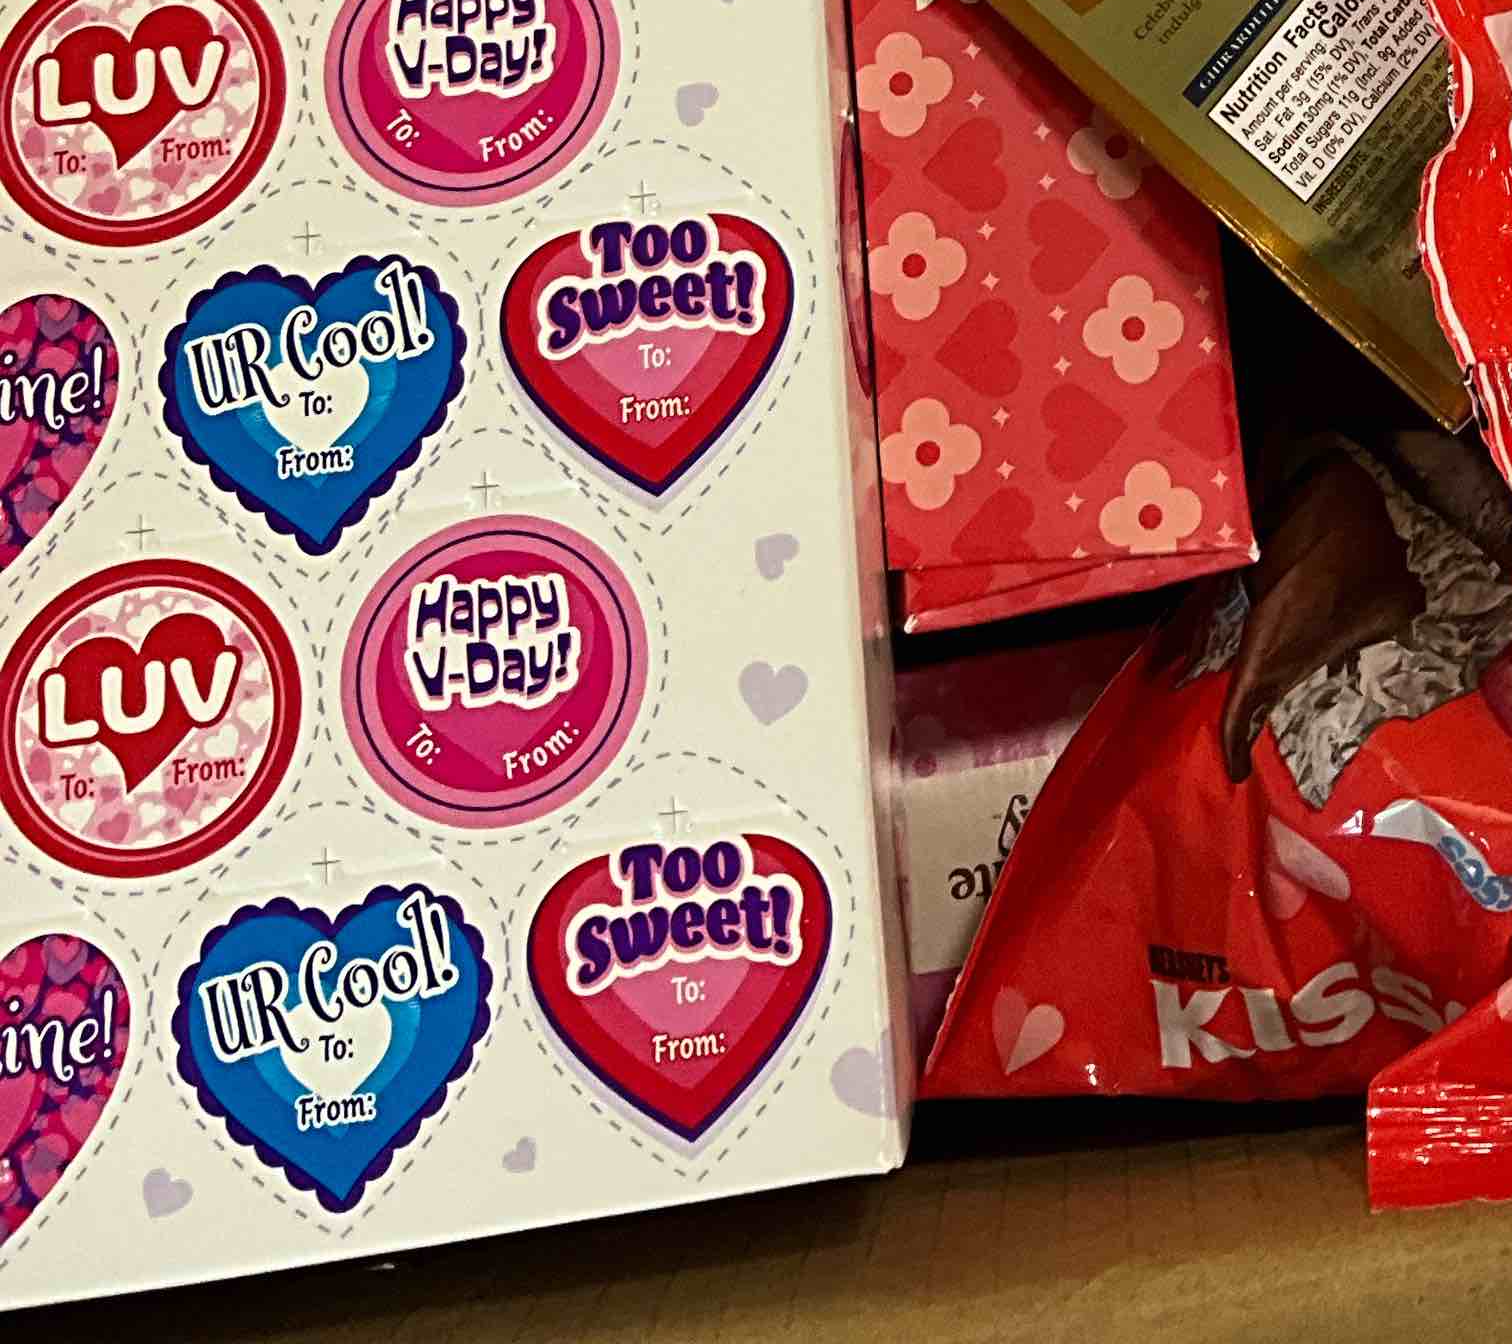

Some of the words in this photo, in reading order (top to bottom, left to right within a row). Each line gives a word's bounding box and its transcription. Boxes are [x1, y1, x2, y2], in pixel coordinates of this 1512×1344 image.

[39, 40, 226, 120] LUV
[395, 30, 547, 87] V-Day!
[1217, 47, 1290, 126] Nutrition
[1239, 96, 1280, 140] Amount
[1274, 79, 1295, 101] per
[1288, 39, 1329, 83] serving:
[1266, 118, 1310, 165] Sodium
[1361, 21, 1390, 52] Total
[55, 150, 88, 175] To:
[162, 136, 232, 163] From:
[385, 111, 423, 149] To:
[480, 111, 555, 162] From:
[589, 222, 707, 269] Too
[191, 333, 290, 410] UR
[285, 262, 430, 375] Cool!
[547, 272, 756, 349] Sweet!
[638, 343, 672, 369] To:
[0, 347, 105, 429] ine!
[301, 391, 333, 417] To:
[620, 394, 691, 421] From:
[279, 445, 352, 473] From:
[416, 578, 563, 639] Happy
[44, 651, 238, 738] LUV
[413, 634, 571, 699] V-Day!
[60, 774, 95, 799] To:
[172, 755, 246, 785] From:
[404, 724, 444, 765] To:
[503, 722, 582, 778] From:
[619, 841, 744, 894] Too
[575, 887, 791, 984] Sweet!
[204, 970, 311, 1059] UR
[302, 896, 456, 1017] Cool!
[671, 977, 707, 1004] To:
[0, 992, 114, 1084] ine!
[1151, 962, 1467, 1069] KISS
[320, 1035, 355, 1061] To:
[653, 1033, 726, 1063] From:
[299, 1094, 376, 1123] From:
